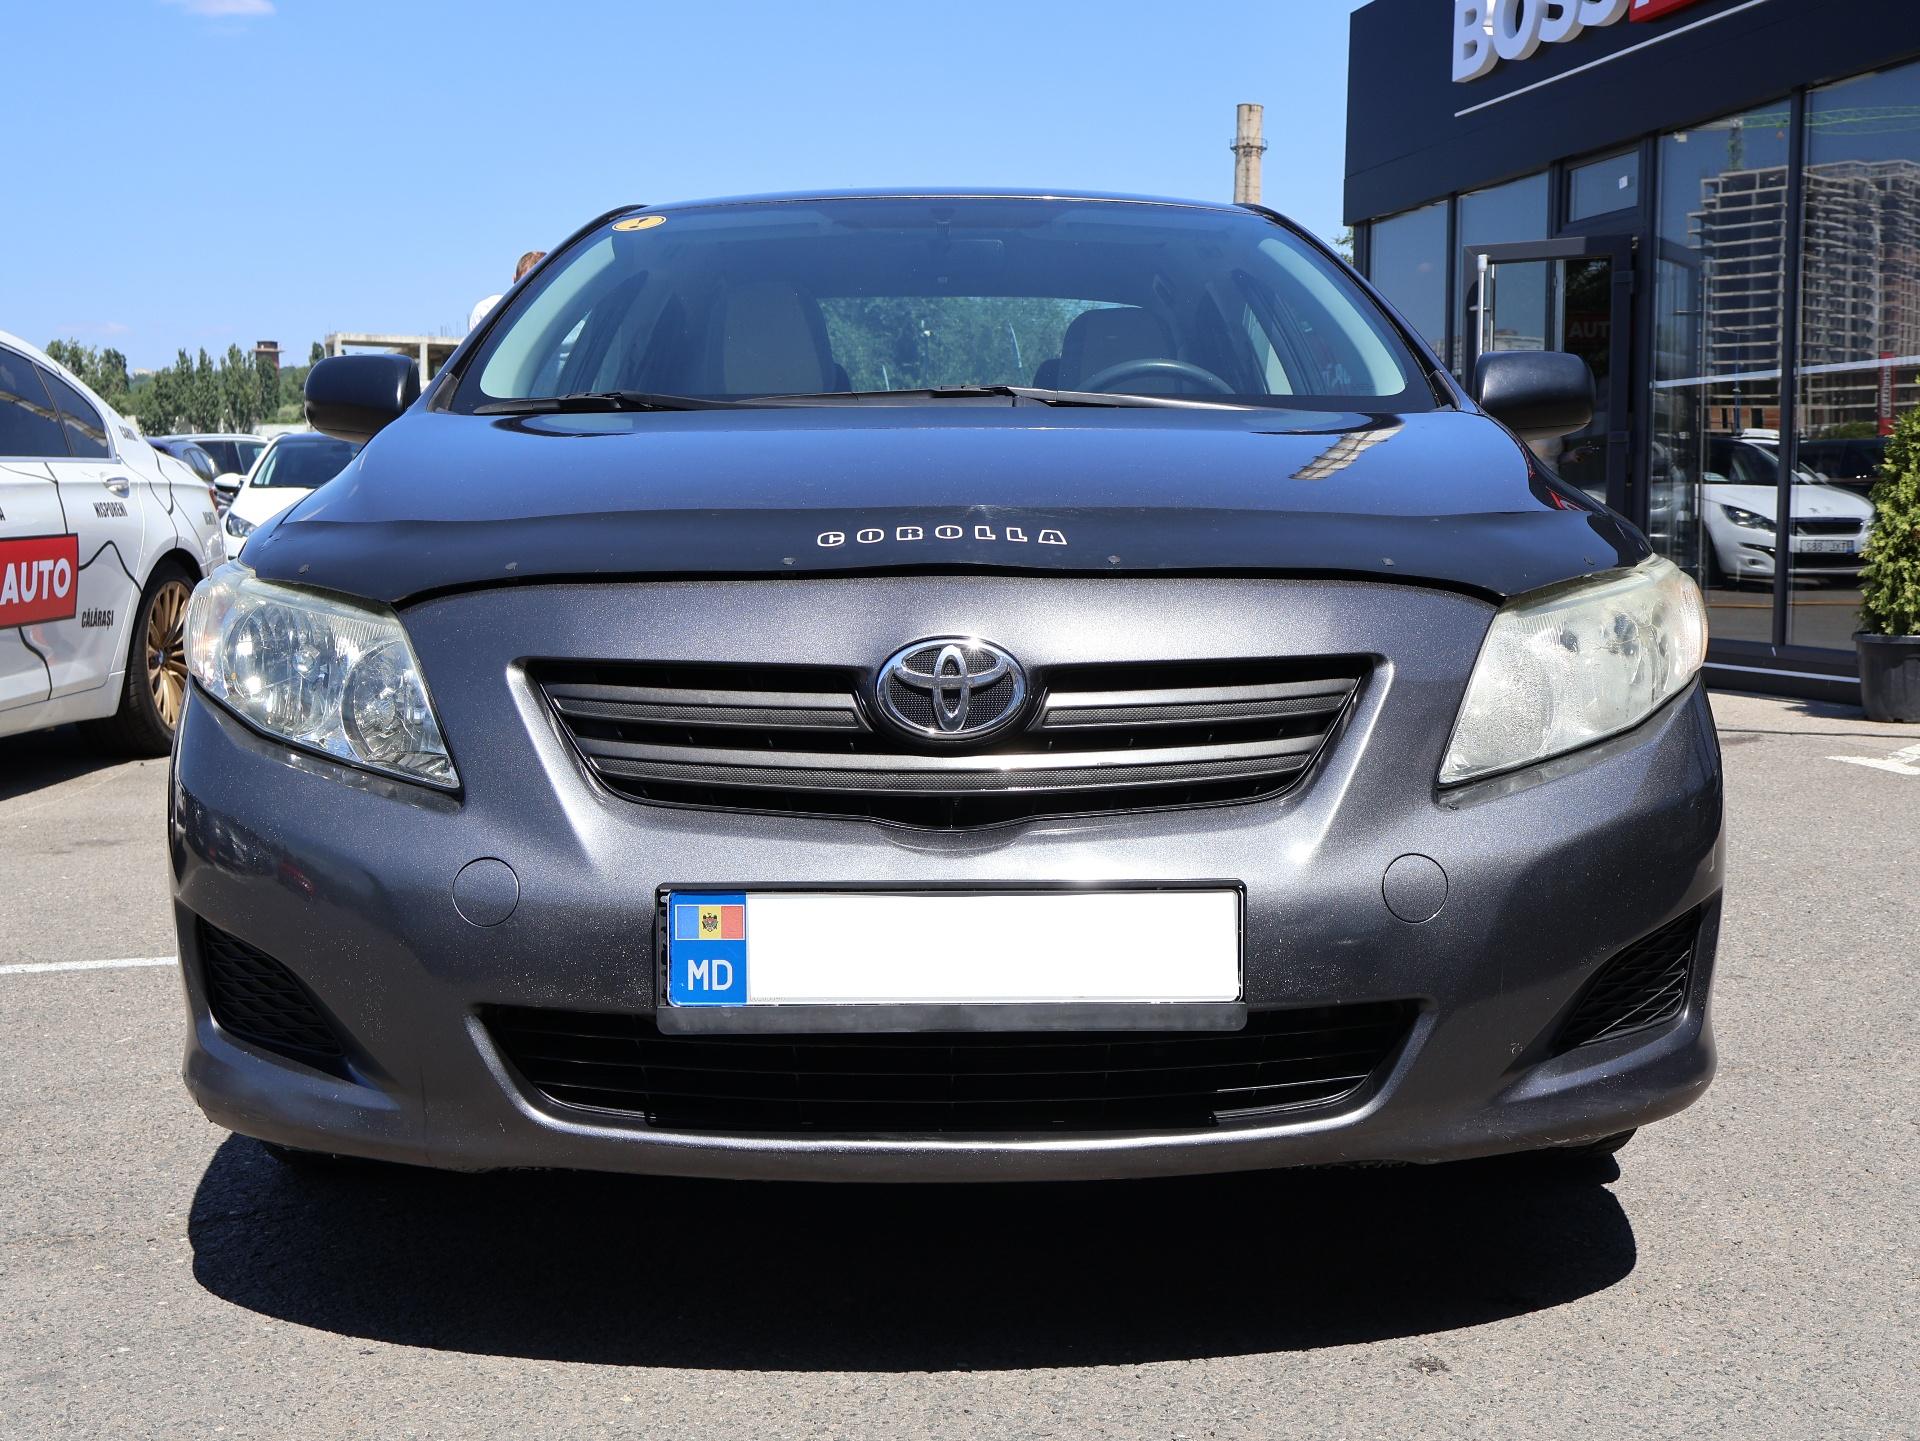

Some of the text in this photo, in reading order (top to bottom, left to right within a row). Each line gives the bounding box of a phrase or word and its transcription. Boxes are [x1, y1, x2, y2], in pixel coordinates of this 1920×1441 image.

[1452, 0, 1630, 83] BO
[93, 502, 128, 518] NISPORENI
[817, 525, 1067, 546] COROLLA
[0, 558, 71, 606] AUTO
[687, 959, 733, 991] MD
